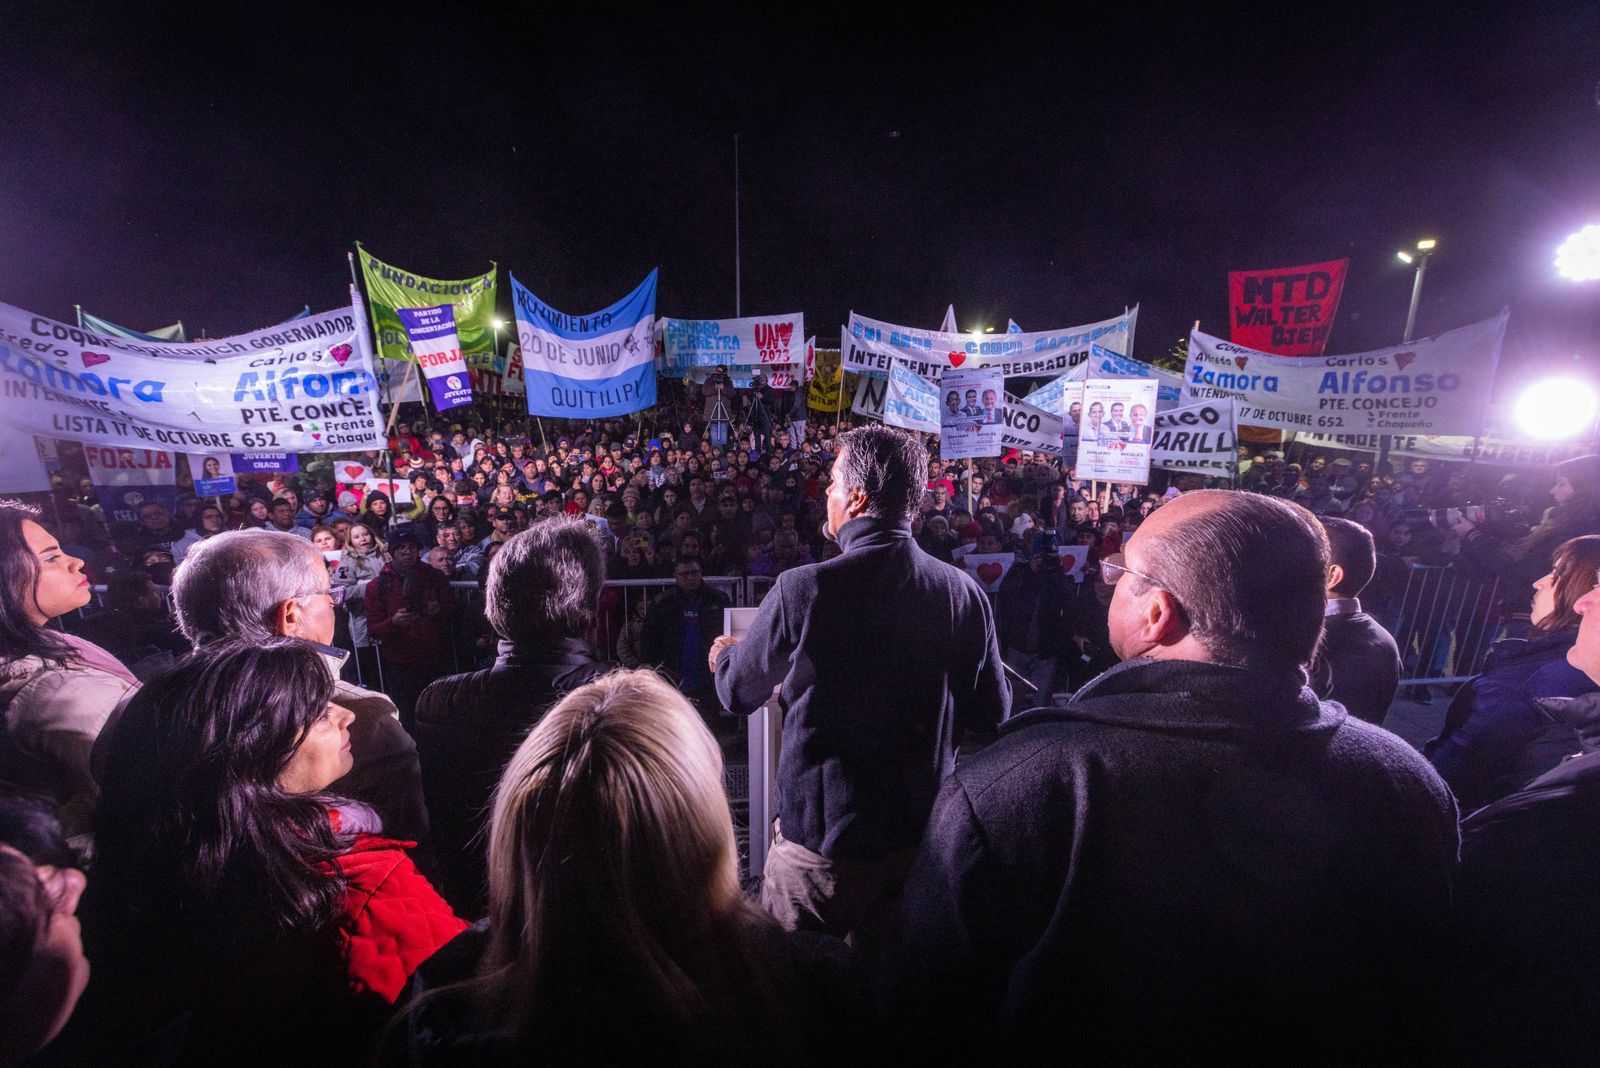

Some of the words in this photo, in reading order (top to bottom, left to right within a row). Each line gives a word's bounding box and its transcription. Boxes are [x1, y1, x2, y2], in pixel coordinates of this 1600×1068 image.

[250, 315, 356, 350] GOBERNADOR
[546, 341, 567, 364] DE
[572, 342, 621, 366] JUNIO
[1325, 356, 1388, 368] Carlos
[1191, 366, 1279, 393] Zamora
[1317, 370, 1461, 394] Alfonso
[551, 380, 640, 409] QUITILIPI
[1319, 398, 1349, 410] PTE.
[1352, 396, 1437, 410] CONCEJO
[240, 406, 288, 425] PTE.
[324, 418, 375, 432] Frente
[1240, 407, 1250, 417] 17
[1253, 408, 1266, 420] DE
[1268, 411, 1312, 426] OCTUBRE
[1318, 417, 1344, 428] 652
[1378, 411, 1421, 419] Frente
[52, 414, 109, 434] LISTA
[111, 421, 128, 436] 17
[131, 425, 154, 441] DE
[156, 431, 234, 448] OCTUBRE
[241, 431, 280, 448] 652
